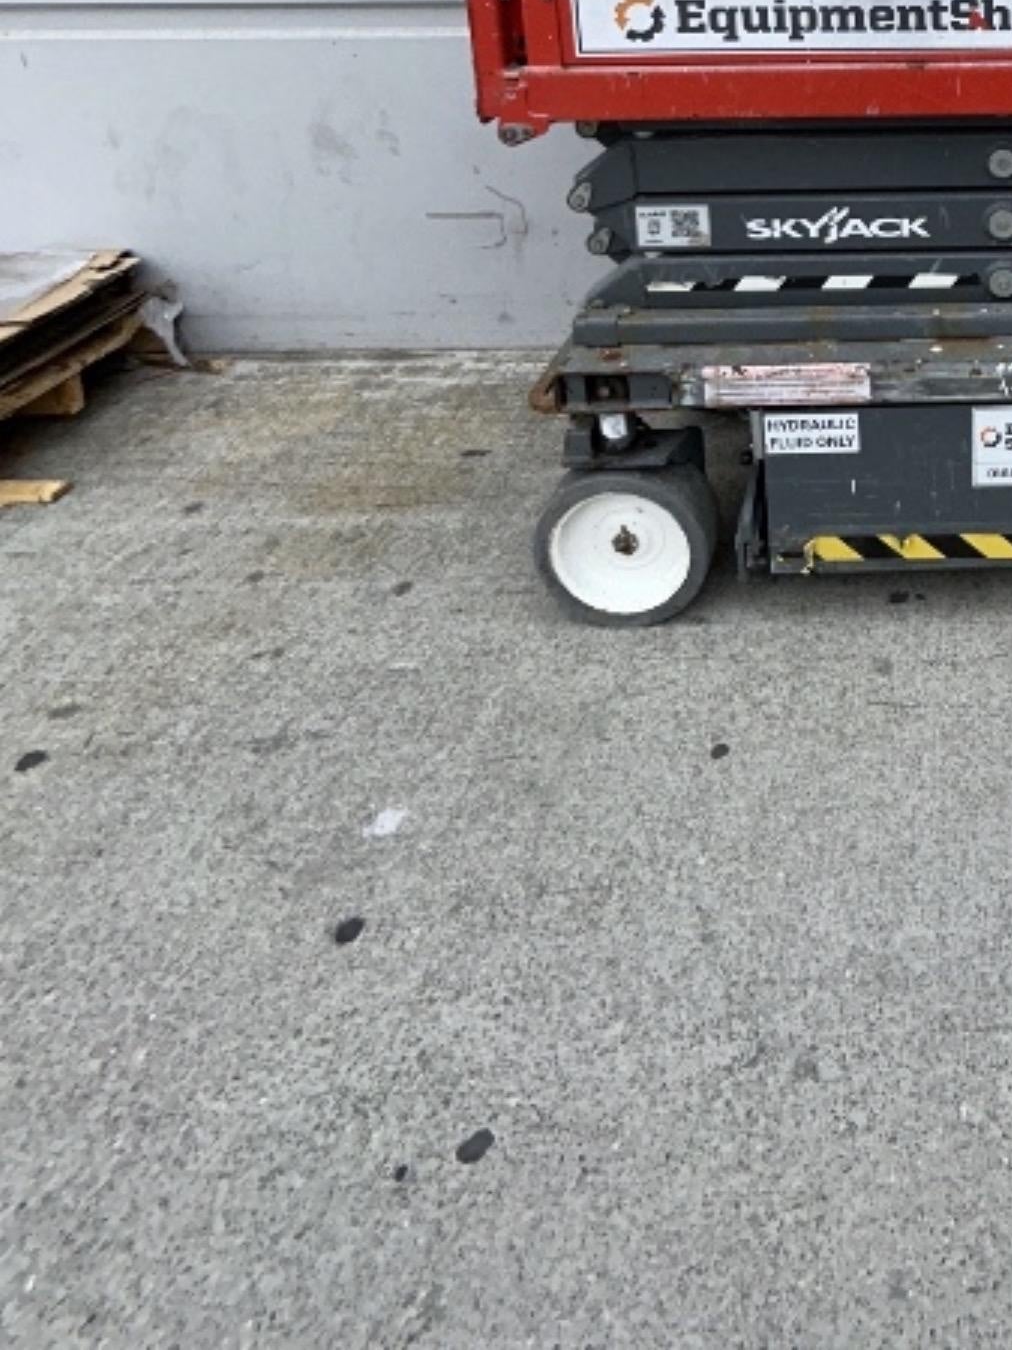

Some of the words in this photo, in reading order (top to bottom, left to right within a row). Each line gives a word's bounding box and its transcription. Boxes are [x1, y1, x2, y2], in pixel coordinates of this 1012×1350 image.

[745, 206, 931, 244] SKYJACK
[767, 417, 856, 432] HYDRAULIC
[769, 436, 814, 450] FLUID
[815, 435, 855, 449] ONLY
